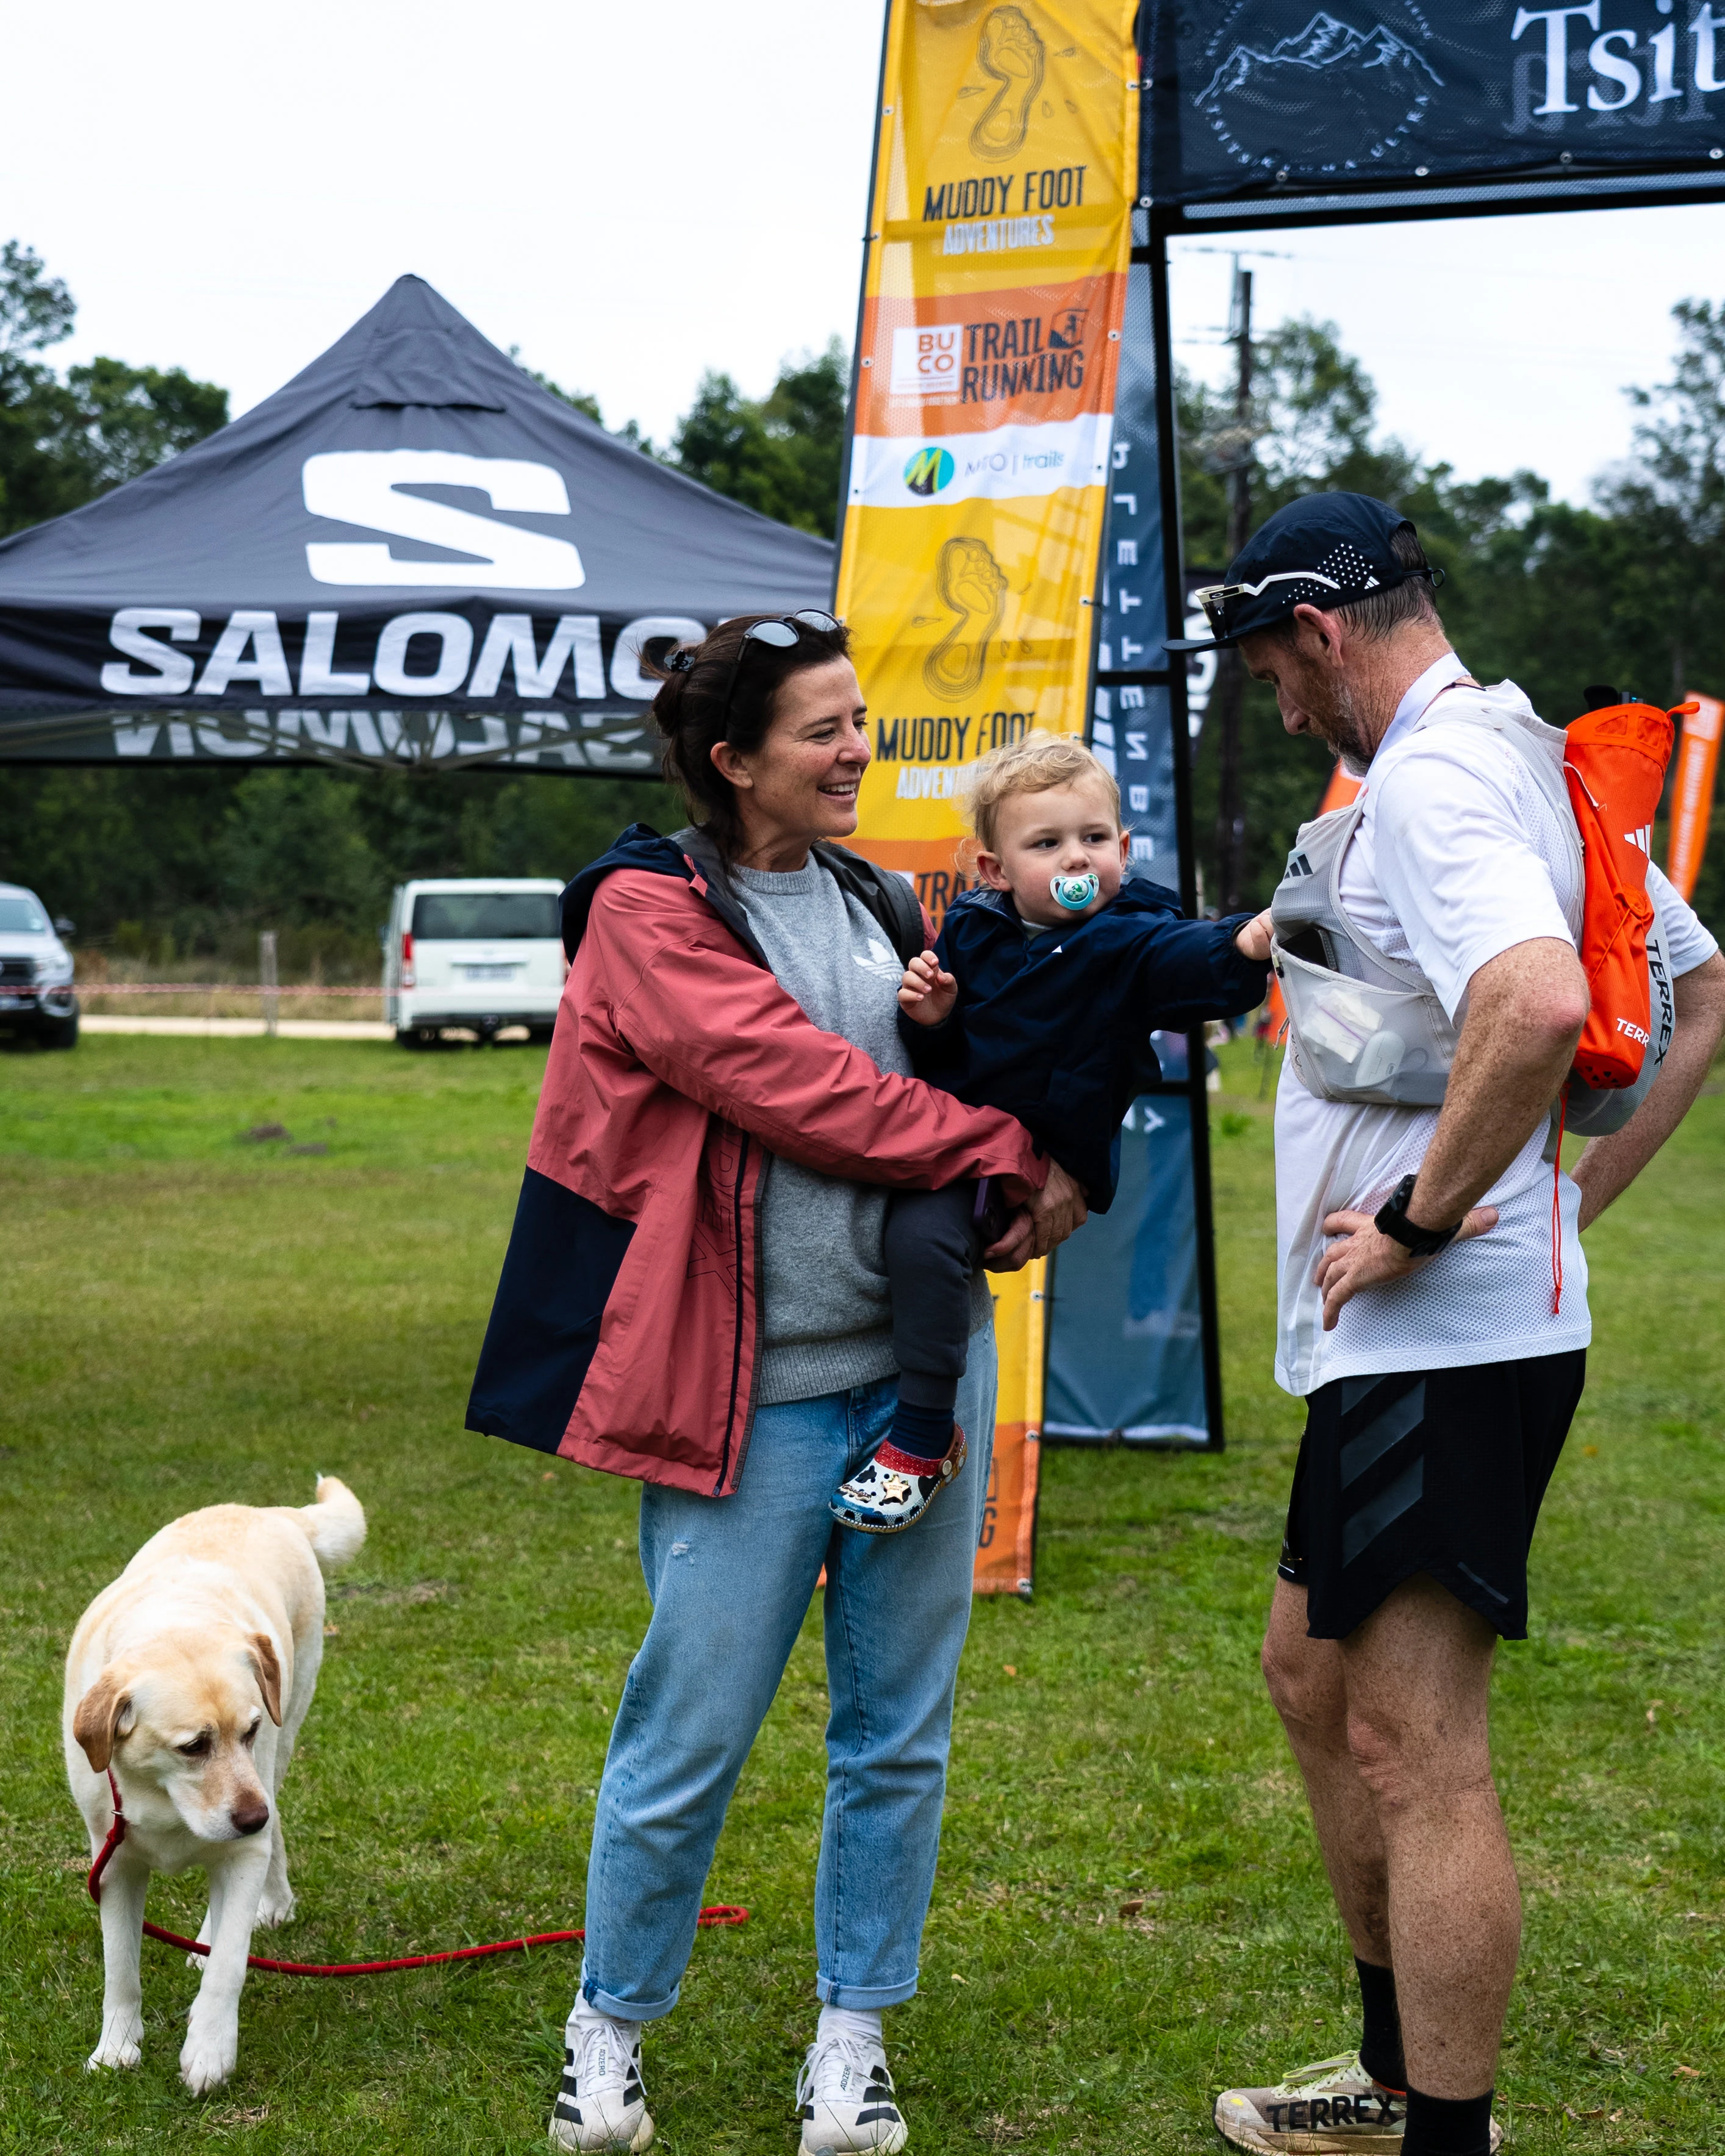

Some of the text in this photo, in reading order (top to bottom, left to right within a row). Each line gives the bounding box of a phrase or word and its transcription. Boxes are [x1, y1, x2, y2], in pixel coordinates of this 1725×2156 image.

[1510, 0, 1725, 115] Tsit
[922, 165, 1087, 222] MUDDY FOOT
[943, 214, 1055, 256] ADVENTURES
[919, 332, 955, 353] BU
[966, 317, 1044, 363] TRAIL
[917, 354, 955, 373] CO
[961, 349, 1084, 404] RUNNING
[100, 607, 720, 697] SALOMO
[877, 717, 972, 761] MUDDY
[896, 766, 971, 799] ADVEN
[917, 871, 980, 911] TRA
[1646, 939, 1673, 1067] TERREX
[1617, 1017, 1649, 1048] TERR
[840, 2064, 852, 2091] ADIZERO
[1266, 2093, 1399, 2133] TERREX
